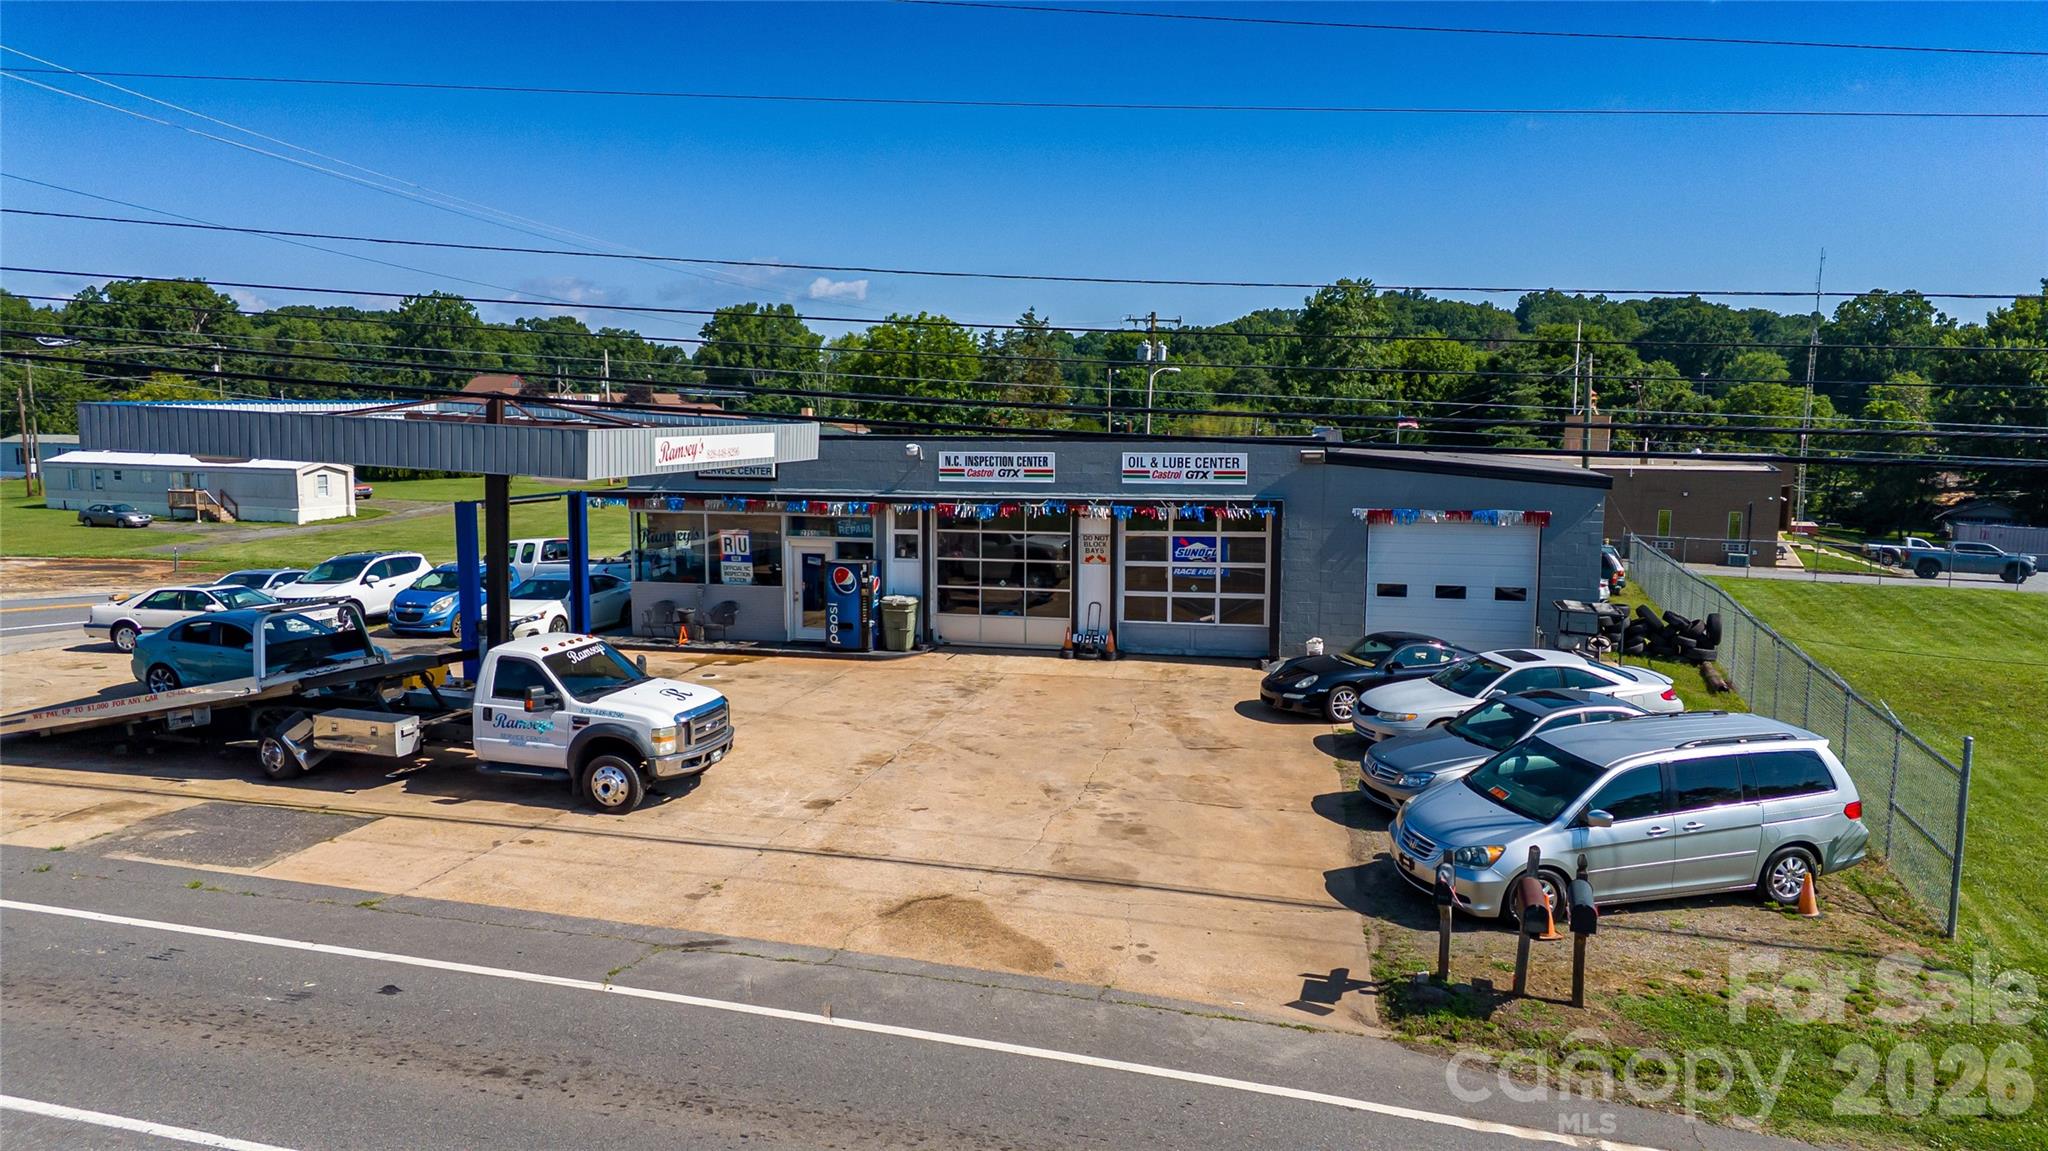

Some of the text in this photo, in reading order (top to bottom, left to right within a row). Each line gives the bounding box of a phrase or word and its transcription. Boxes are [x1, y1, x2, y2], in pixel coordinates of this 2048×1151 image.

[659, 438, 704, 463] Ramsey's
[945, 455, 1048, 467] N.C. INSPECTION CENTER
[1128, 456, 1240, 469] OIL & LUBE CENTER
[738, 465, 772, 476] CENTER
[966, 468, 1021, 478] Castrol GTX
[1152, 470, 1210, 480] Castrol GTX
[838, 523, 871, 535] REPAIR
[828, 602, 841, 644] pepsi
[1076, 633, 1108, 644] OPEN
[32, 712, 43, 720] WE
[46, 710, 58, 718] PAY
[62, 707, 71, 715] UP
[87, 702, 109, 712] $1,000
[112, 700, 125, 708] FOR
[128, 697, 141, 705] ANY
[144, 694, 158, 702] CAR
